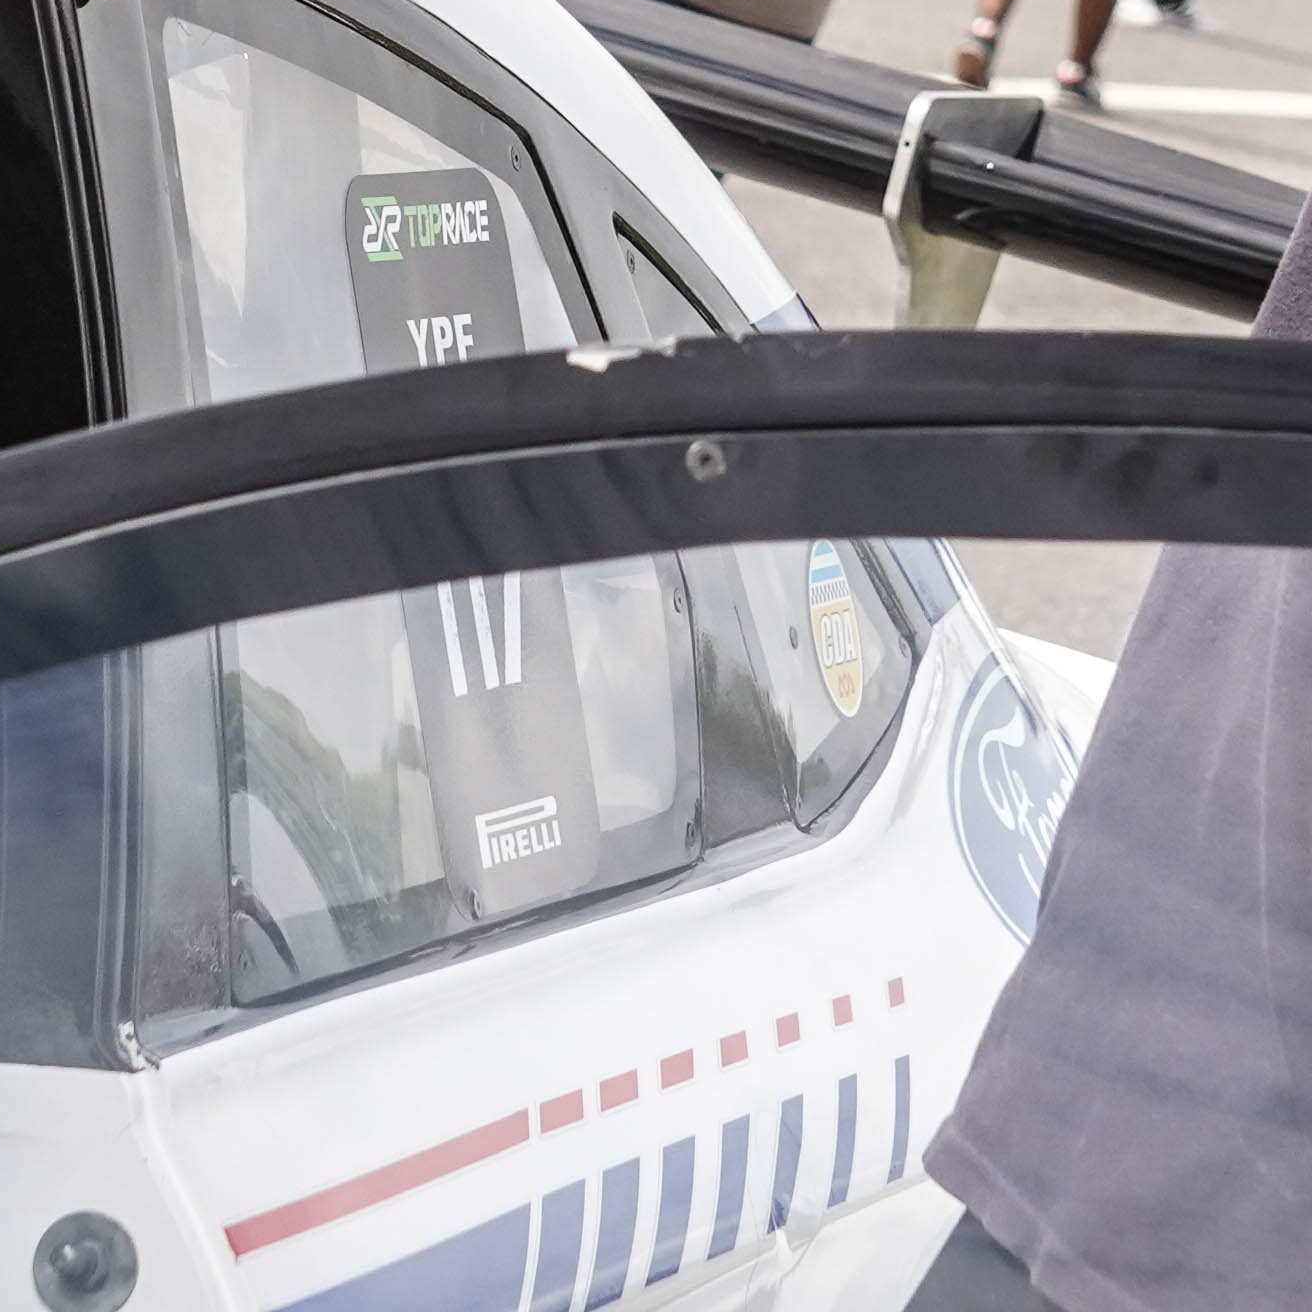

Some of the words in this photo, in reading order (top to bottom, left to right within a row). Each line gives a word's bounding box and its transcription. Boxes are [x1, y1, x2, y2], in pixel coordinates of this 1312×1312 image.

[406, 313, 474, 368] YPF
[819, 607, 858, 669] CDA
[475, 795, 562, 869] PIRELLI
